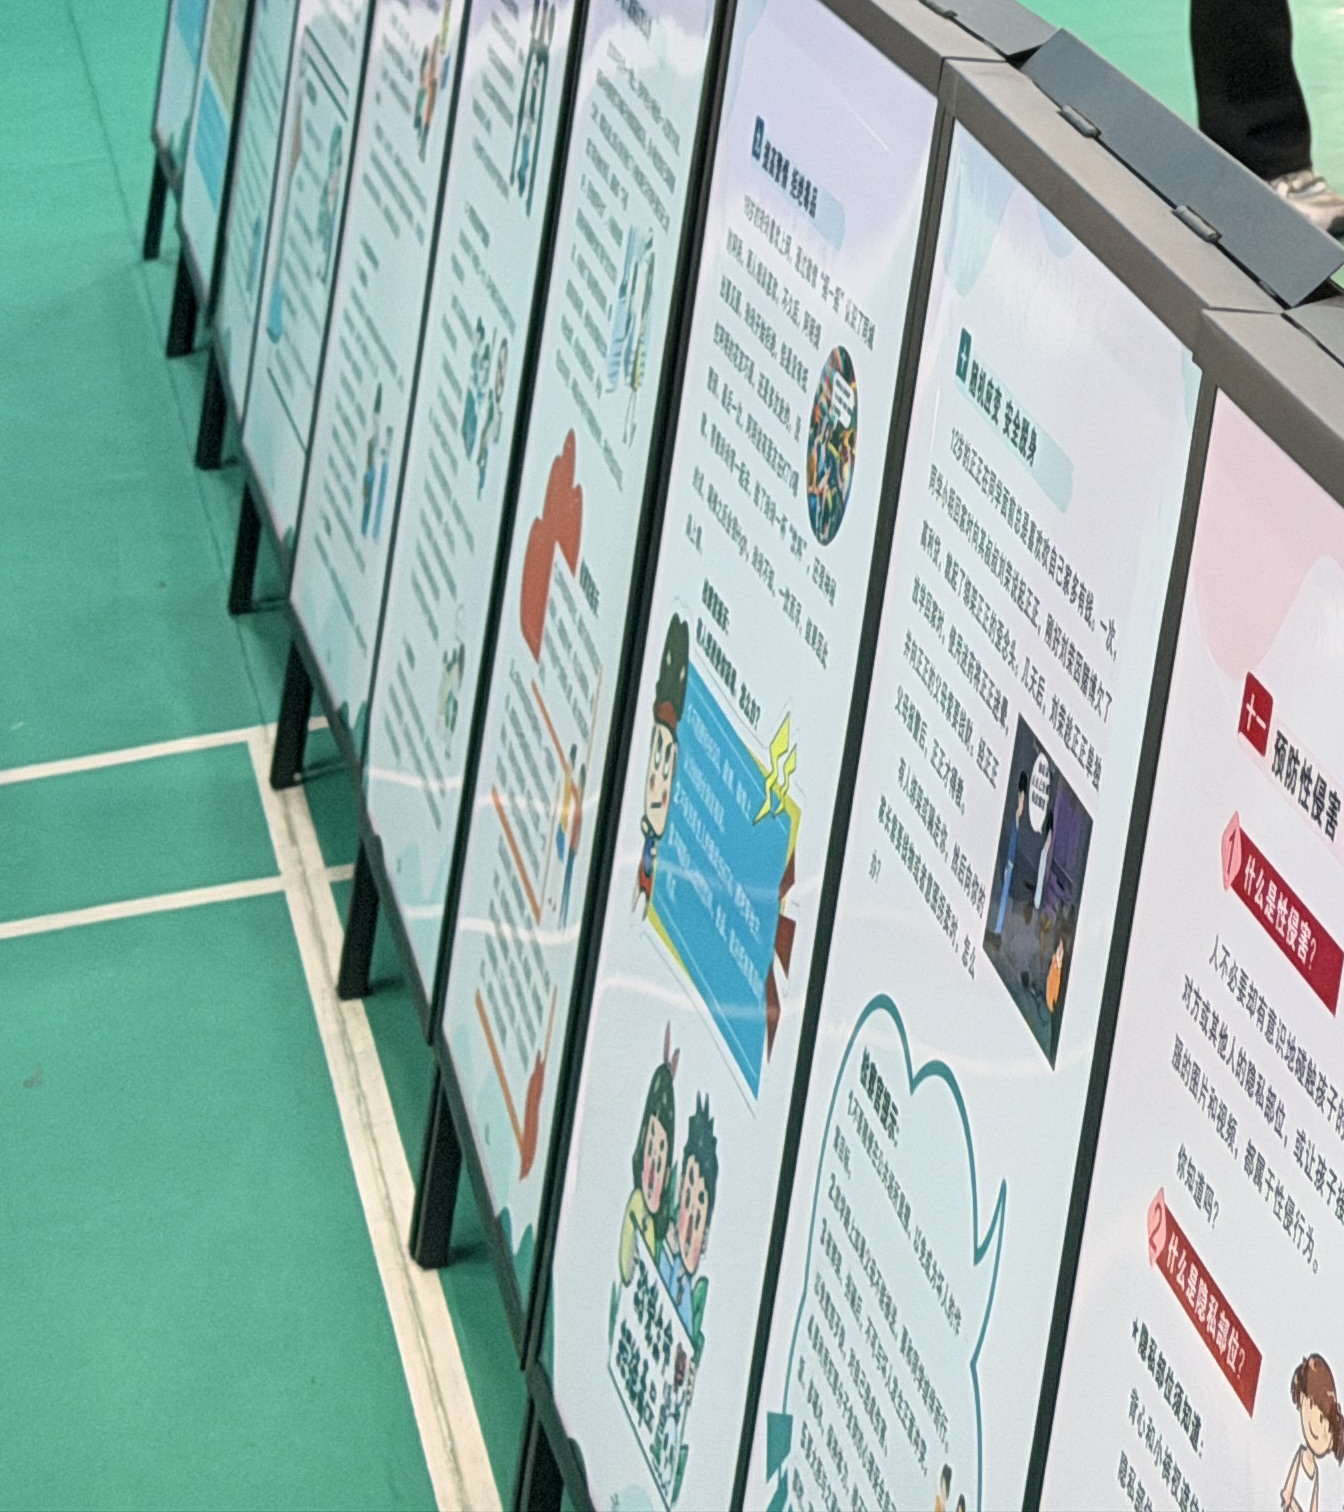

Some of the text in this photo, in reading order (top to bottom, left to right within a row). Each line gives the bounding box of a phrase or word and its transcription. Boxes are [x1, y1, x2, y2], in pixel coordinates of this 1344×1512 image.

[968, 359, 1003, 426] 随机应变
[1002, 399, 1038, 467] 安全脱身
[1245, 693, 1267, 731] 十一
[1271, 729, 1342, 843] 预防性侵害
[1226, 828, 1317, 970] 1 什么是性侵害？
[1176, 1143, 1220, 1230] 你知道吗？
[1148, 1201, 1246, 1379] 2 什么是隐私部位？
